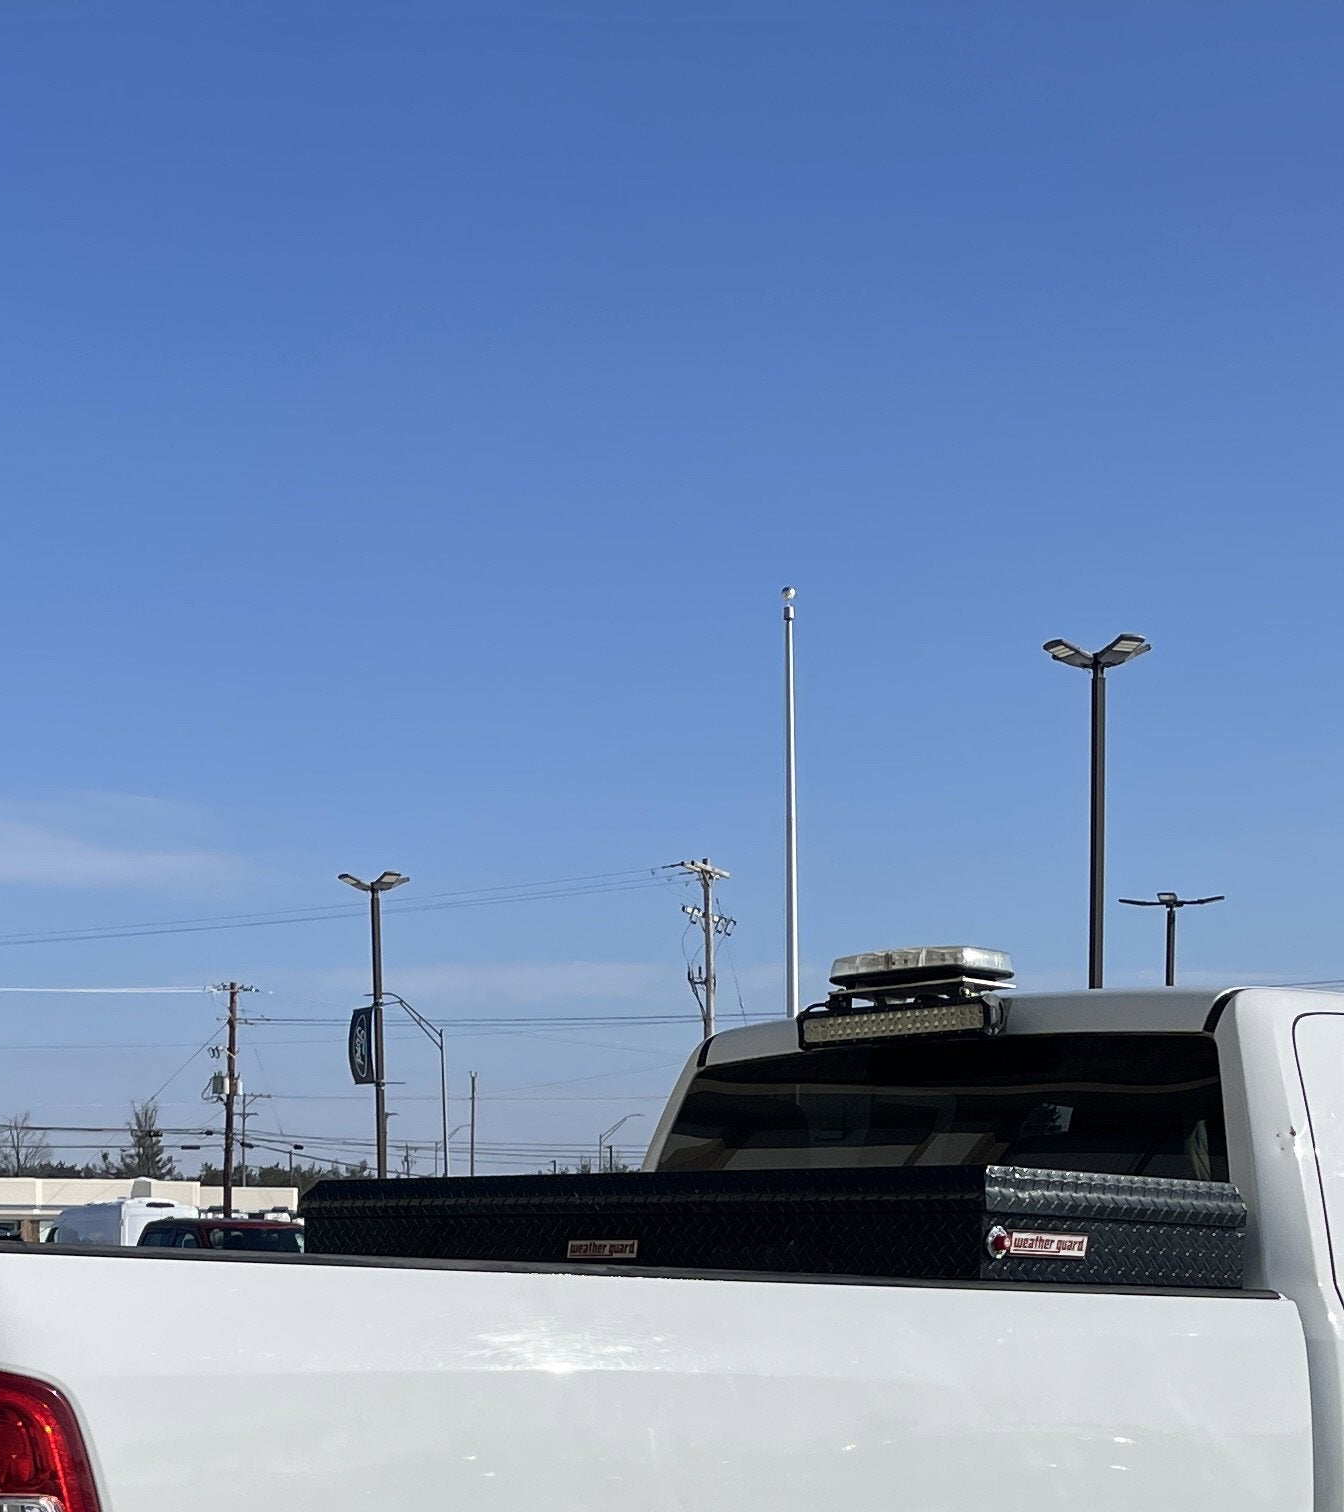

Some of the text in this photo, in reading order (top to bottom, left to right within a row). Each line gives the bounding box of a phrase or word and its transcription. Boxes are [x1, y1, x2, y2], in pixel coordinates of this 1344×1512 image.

[570, 1241, 635, 1257] weather guard
[1014, 1236, 1085, 1253] weather guard
